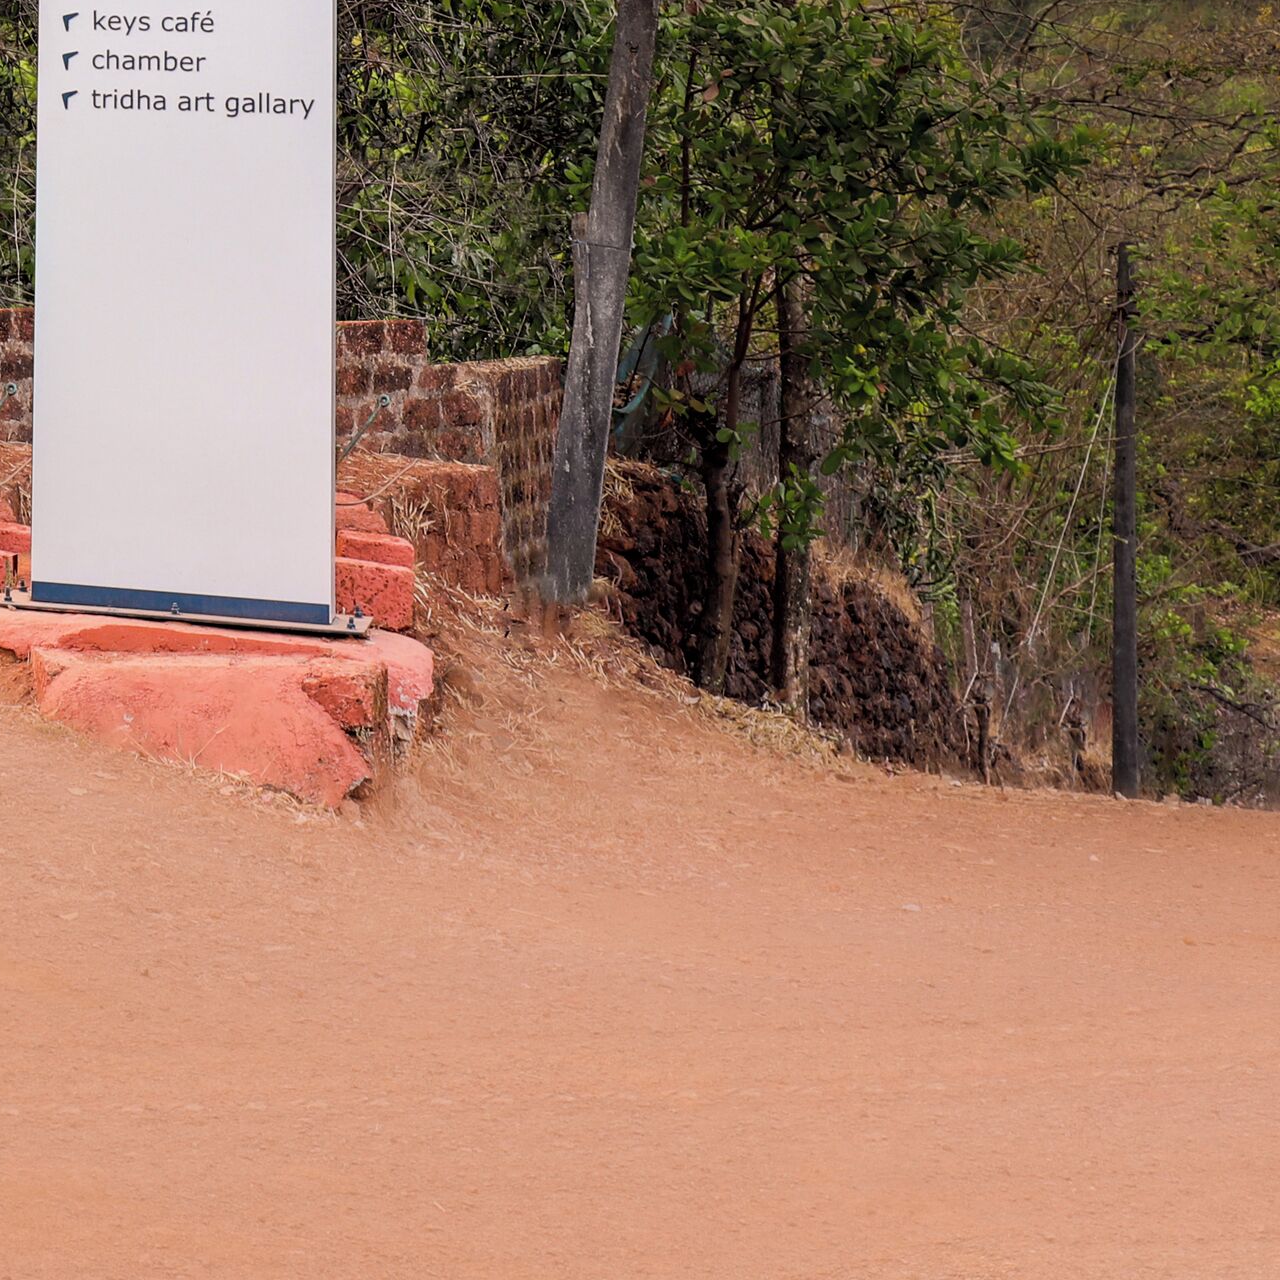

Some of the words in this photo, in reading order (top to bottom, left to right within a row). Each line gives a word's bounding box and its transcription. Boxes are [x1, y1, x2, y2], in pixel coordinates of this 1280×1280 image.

[93, 10, 151, 36] keys
[161, 11, 215, 33] café
[92, 50, 206, 72] chamber
[92, 89, 167, 111] tridha
[178, 92, 215, 112] art
[225, 93, 315, 119] gallary
